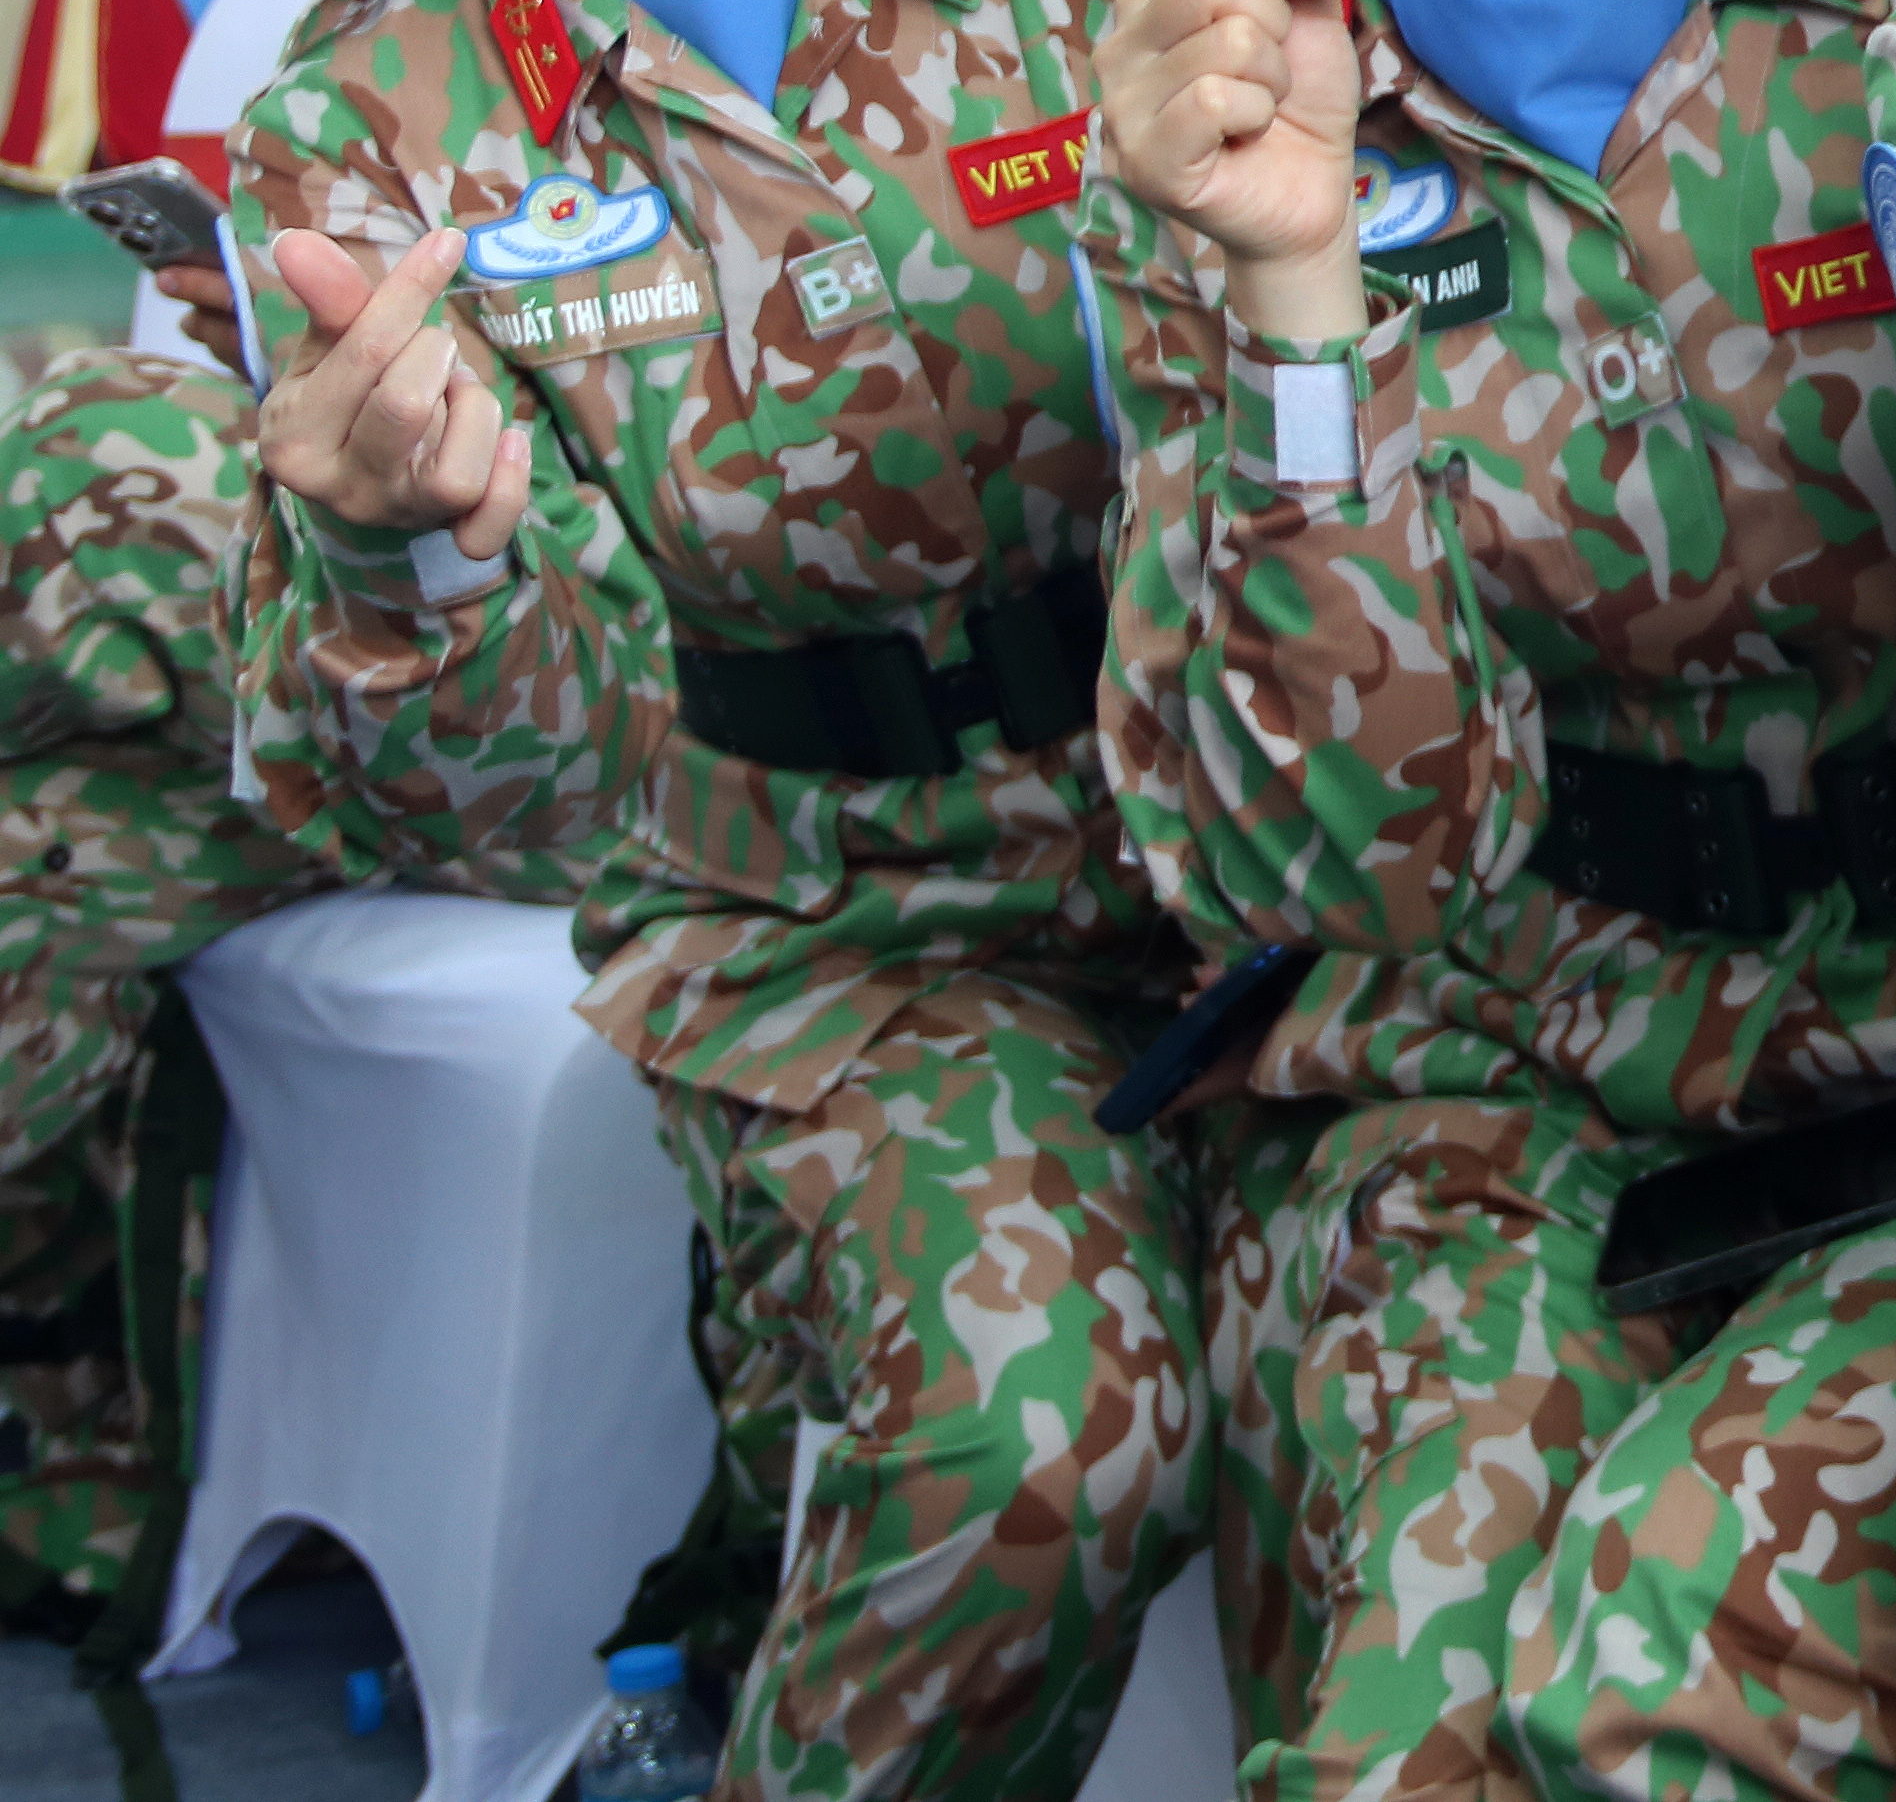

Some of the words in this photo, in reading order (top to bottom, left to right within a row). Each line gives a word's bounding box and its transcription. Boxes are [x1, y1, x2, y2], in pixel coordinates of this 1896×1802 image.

[969, 149, 1051, 198] VIET
[801, 259, 879, 320] B+
[1436, 259, 1481, 302] ANH
[1773, 250, 1872, 307] VIET
[559, 297, 607, 337] THỊ
